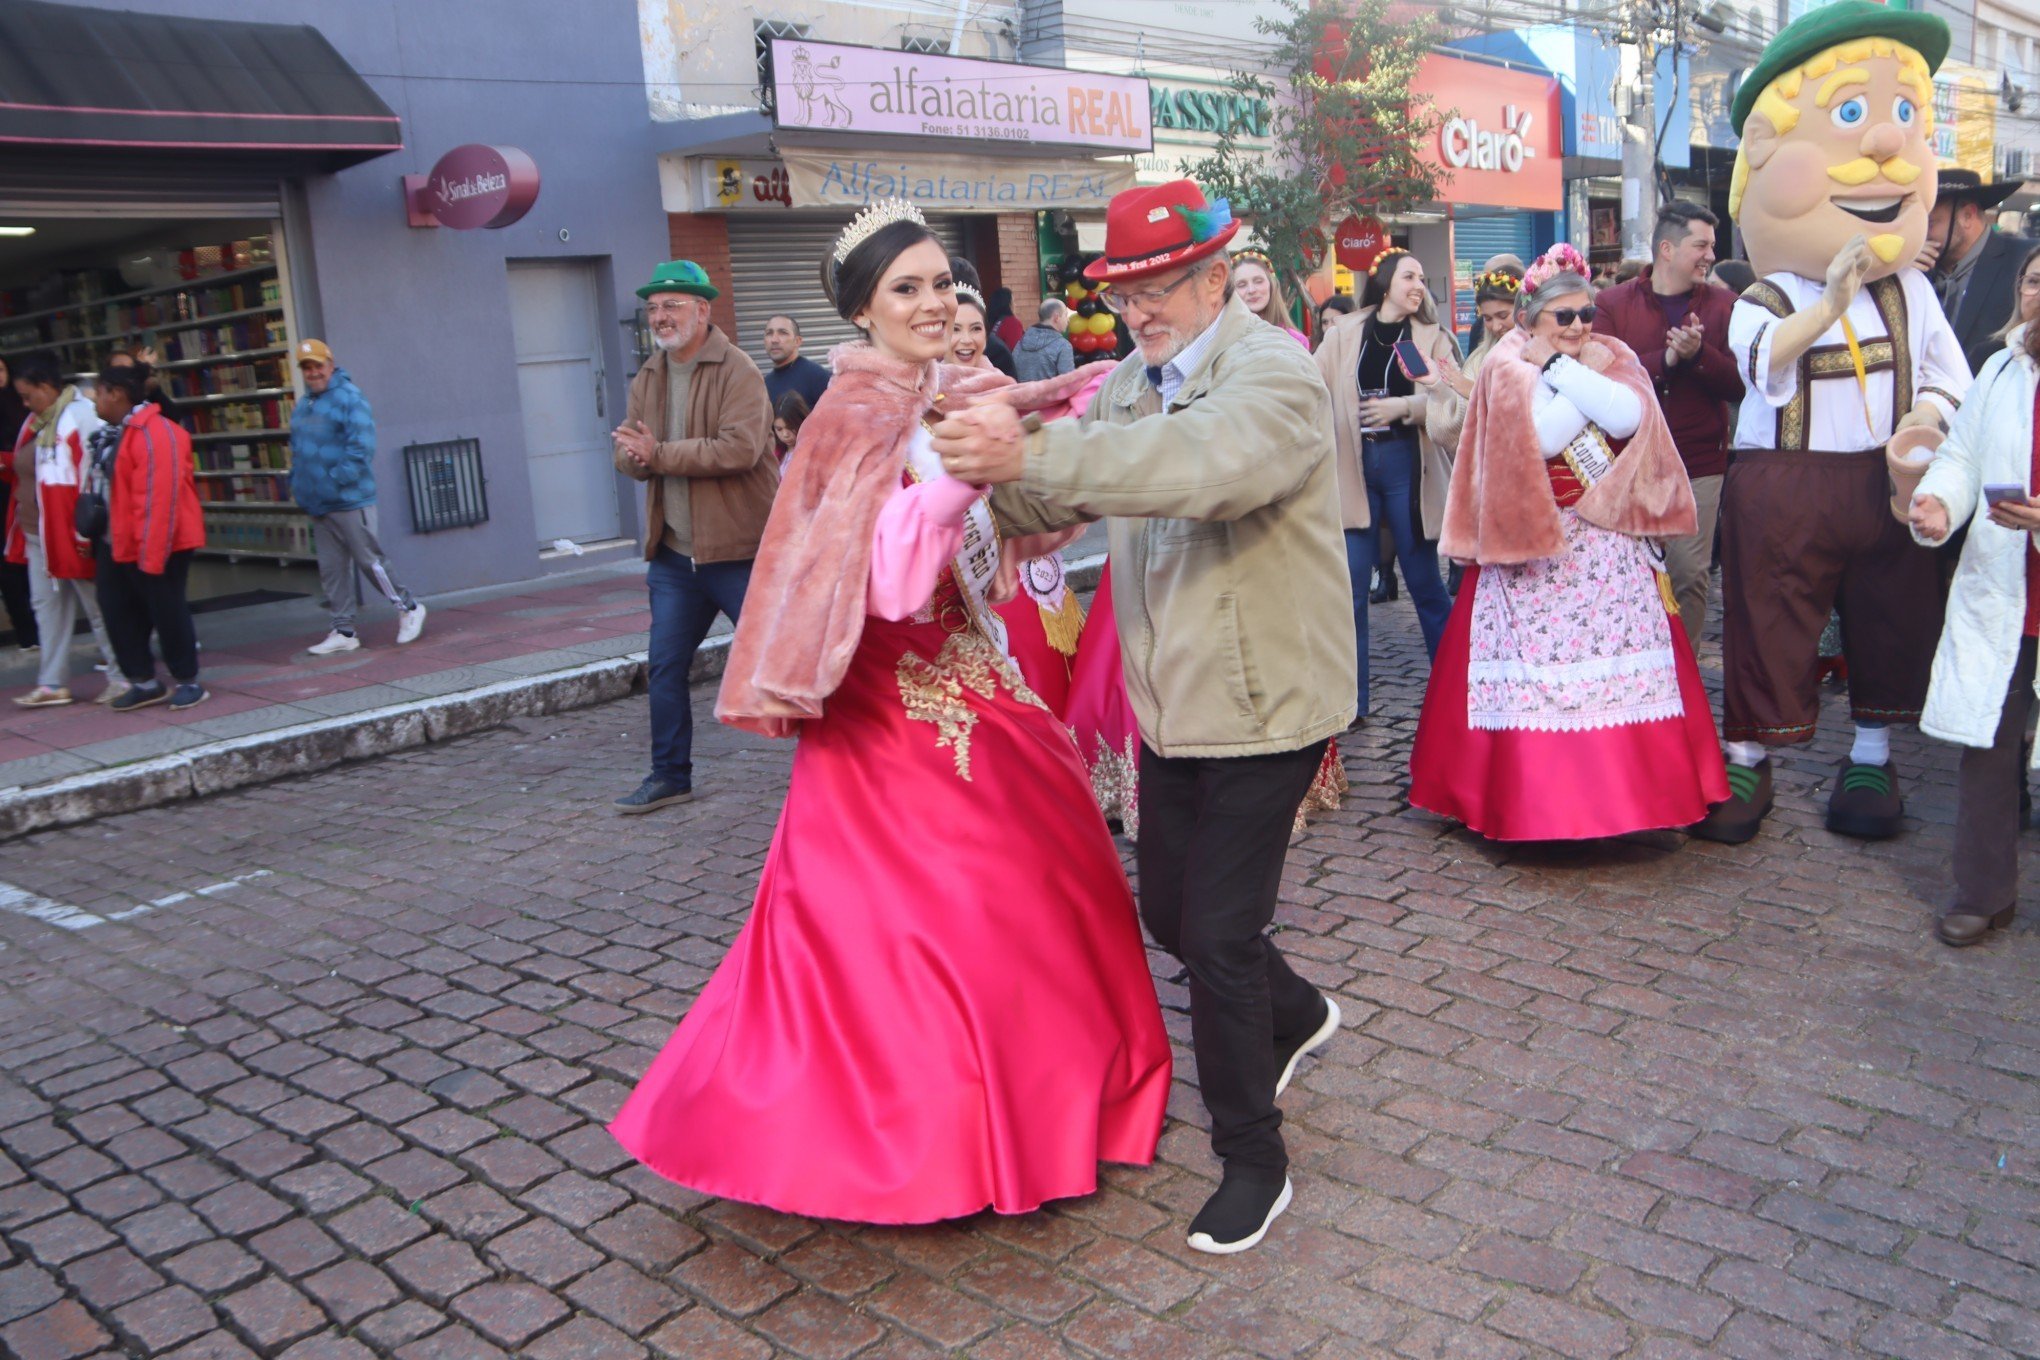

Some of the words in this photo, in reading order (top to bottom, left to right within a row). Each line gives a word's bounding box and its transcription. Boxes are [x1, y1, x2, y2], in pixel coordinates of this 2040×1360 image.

[870, 66, 1060, 126] alfaiataria
[1067, 86, 1142, 139] REAL
[921, 122, 953, 136] Fone:
[956, 124, 970, 136] 51
[973, 126, 1030, 139] 3136.0102
[1441, 116, 1524, 174] Claro
[1135, 154, 1170, 173] culos
[448, 177, 469, 201] Sinal
[476, 172, 507, 194] Beleza
[1025, 173, 1112, 201] REAL
[1149, 253, 1171, 267] 2012
